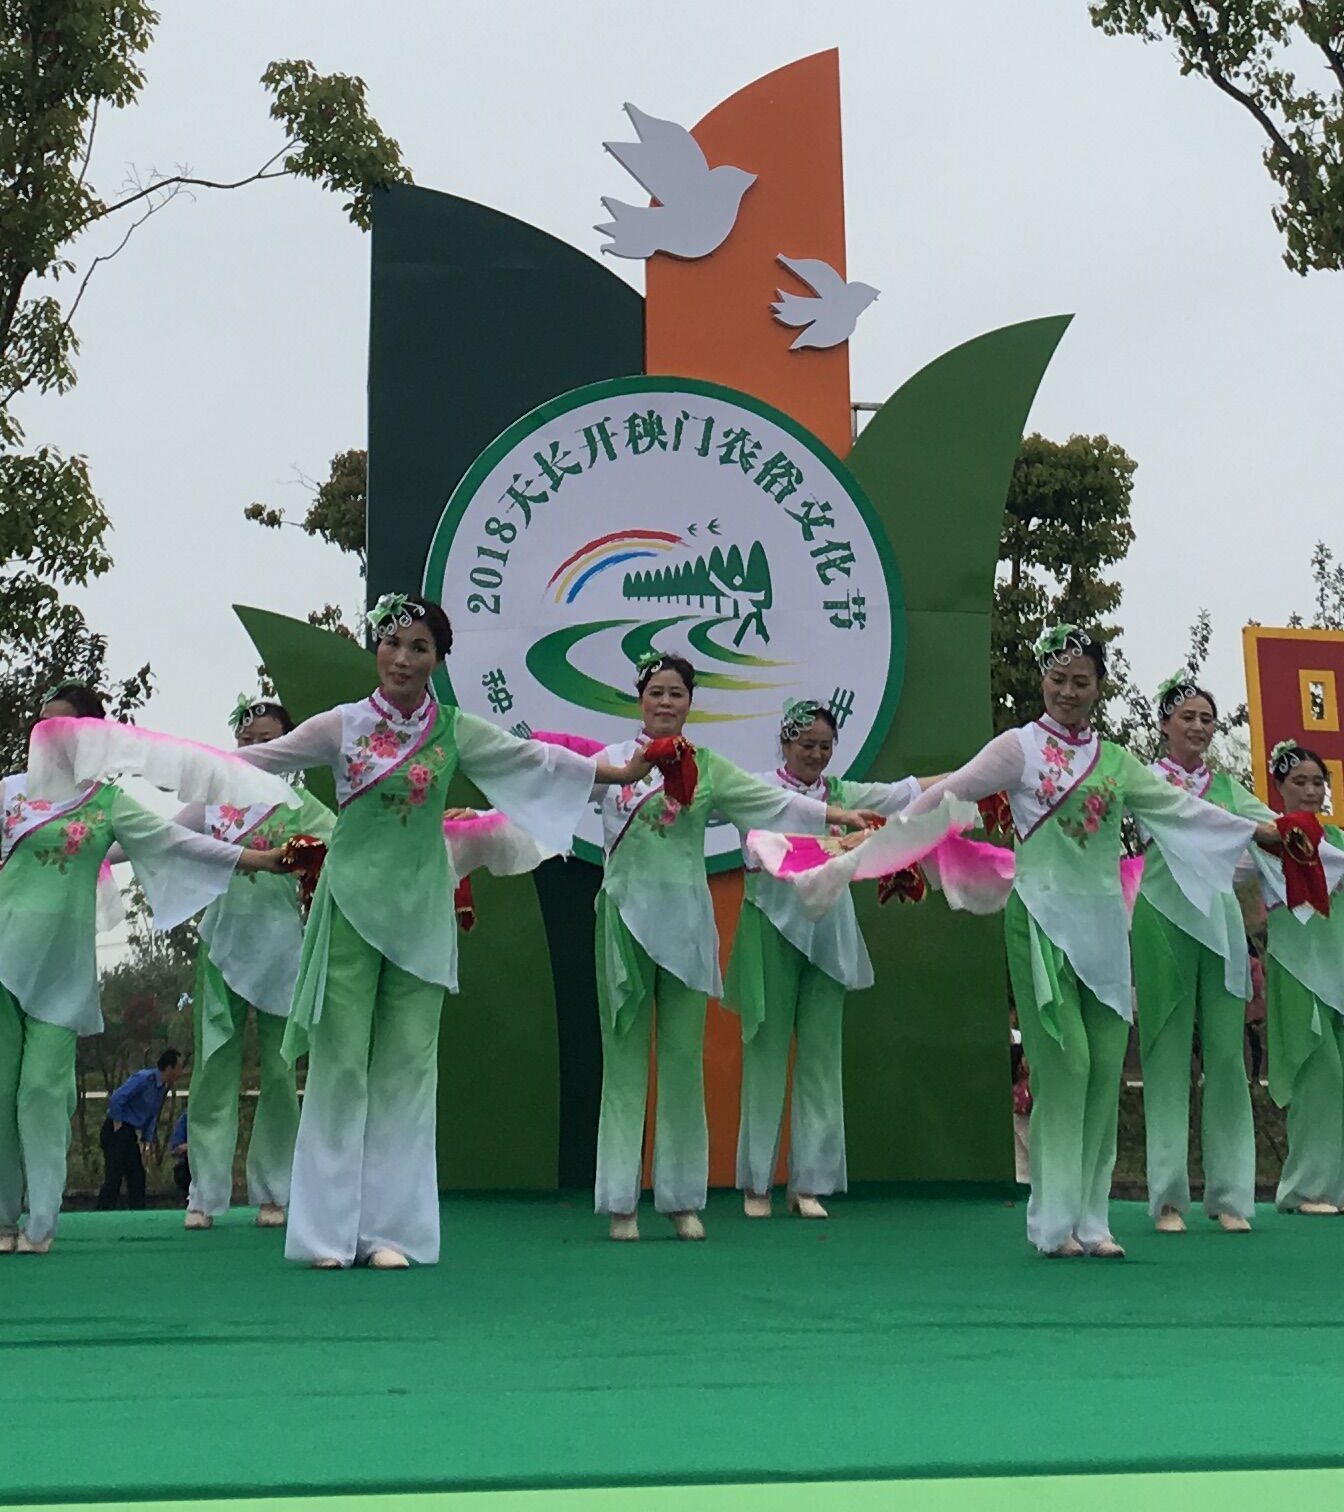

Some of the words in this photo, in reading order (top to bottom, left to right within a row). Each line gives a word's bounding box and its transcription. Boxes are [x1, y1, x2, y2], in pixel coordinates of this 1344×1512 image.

[467, 409, 867, 631] 2018天长开秧门农俗文化节
